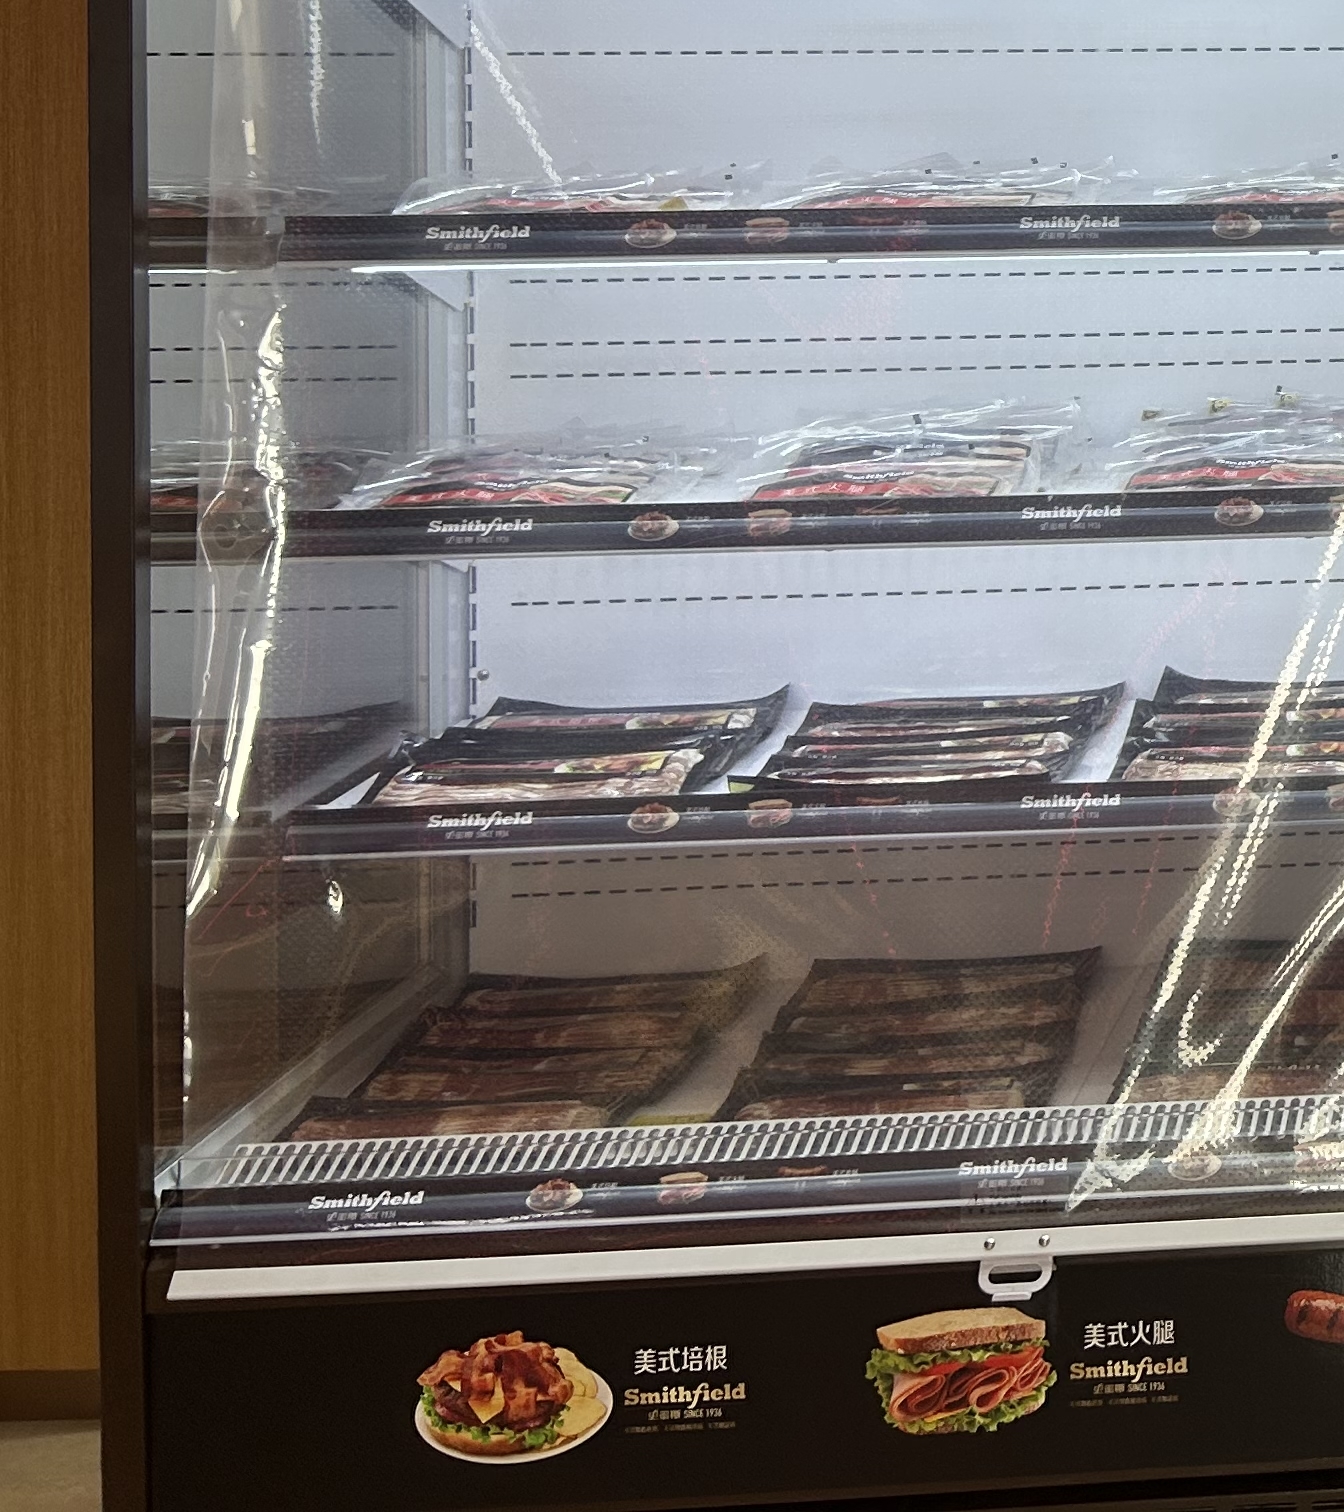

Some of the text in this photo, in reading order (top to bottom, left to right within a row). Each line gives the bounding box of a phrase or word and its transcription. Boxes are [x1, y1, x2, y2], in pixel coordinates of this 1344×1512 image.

[1020, 214, 1120, 232] Smithfield
[426, 224, 530, 242] Smithfield
[1022, 504, 1122, 522] Smithfield
[427, 517, 533, 536] Smithfield
[1020, 793, 1121, 812] Smithfield
[427, 811, 533, 830] Smithfield
[958, 1157, 1068, 1178] Smithfield
[308, 1190, 425, 1210] Smithfield
[1083, 1319, 1175, 1349] 美式火腿
[634, 1345, 728, 1375] 美式培根
[1070, 1356, 1188, 1383] Smithfield
[624, 1382, 746, 1409] Smithfield
